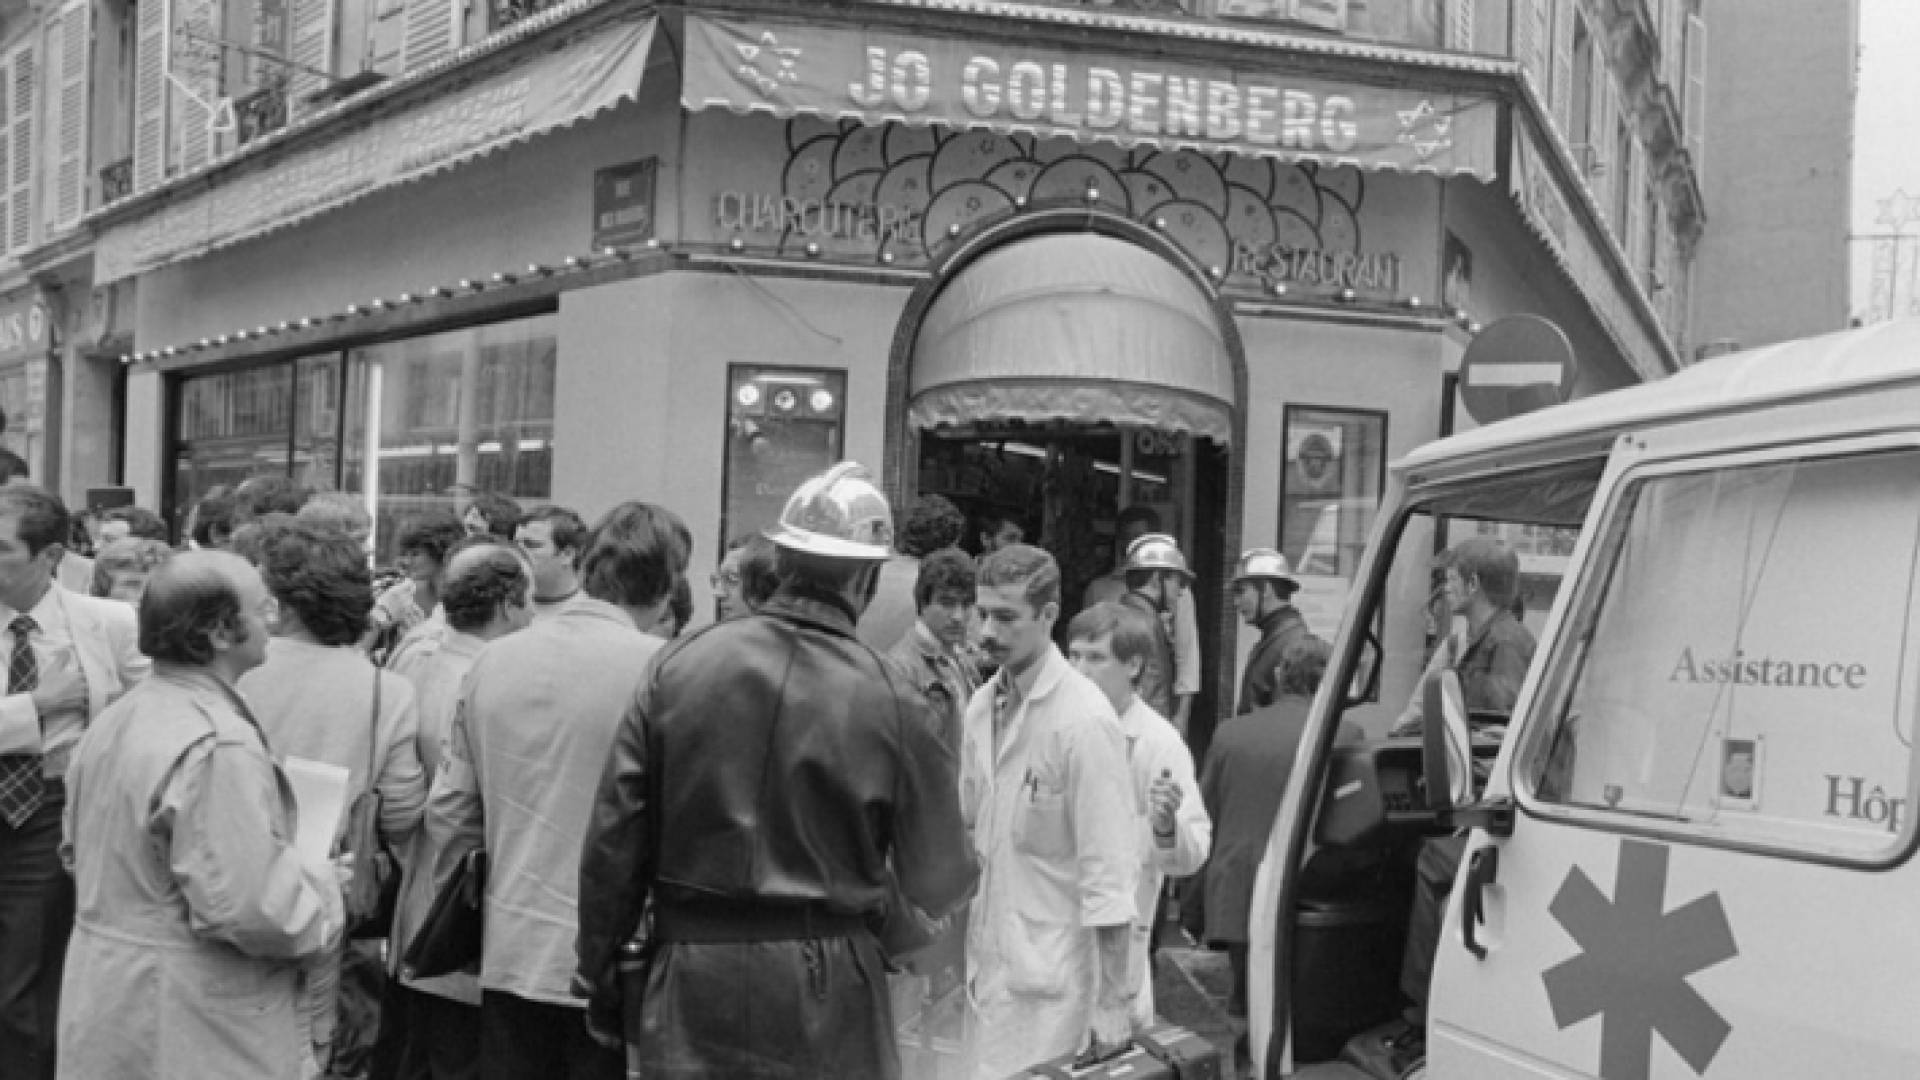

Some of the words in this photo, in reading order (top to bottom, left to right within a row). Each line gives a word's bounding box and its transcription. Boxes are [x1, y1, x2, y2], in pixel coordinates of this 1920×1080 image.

[848, 45, 931, 111] JO
[962, 55, 1359, 152] GOLDENBERG
[1232, 241, 1401, 291] RESTAURANT
[1668, 646, 1867, 689] Assistance
